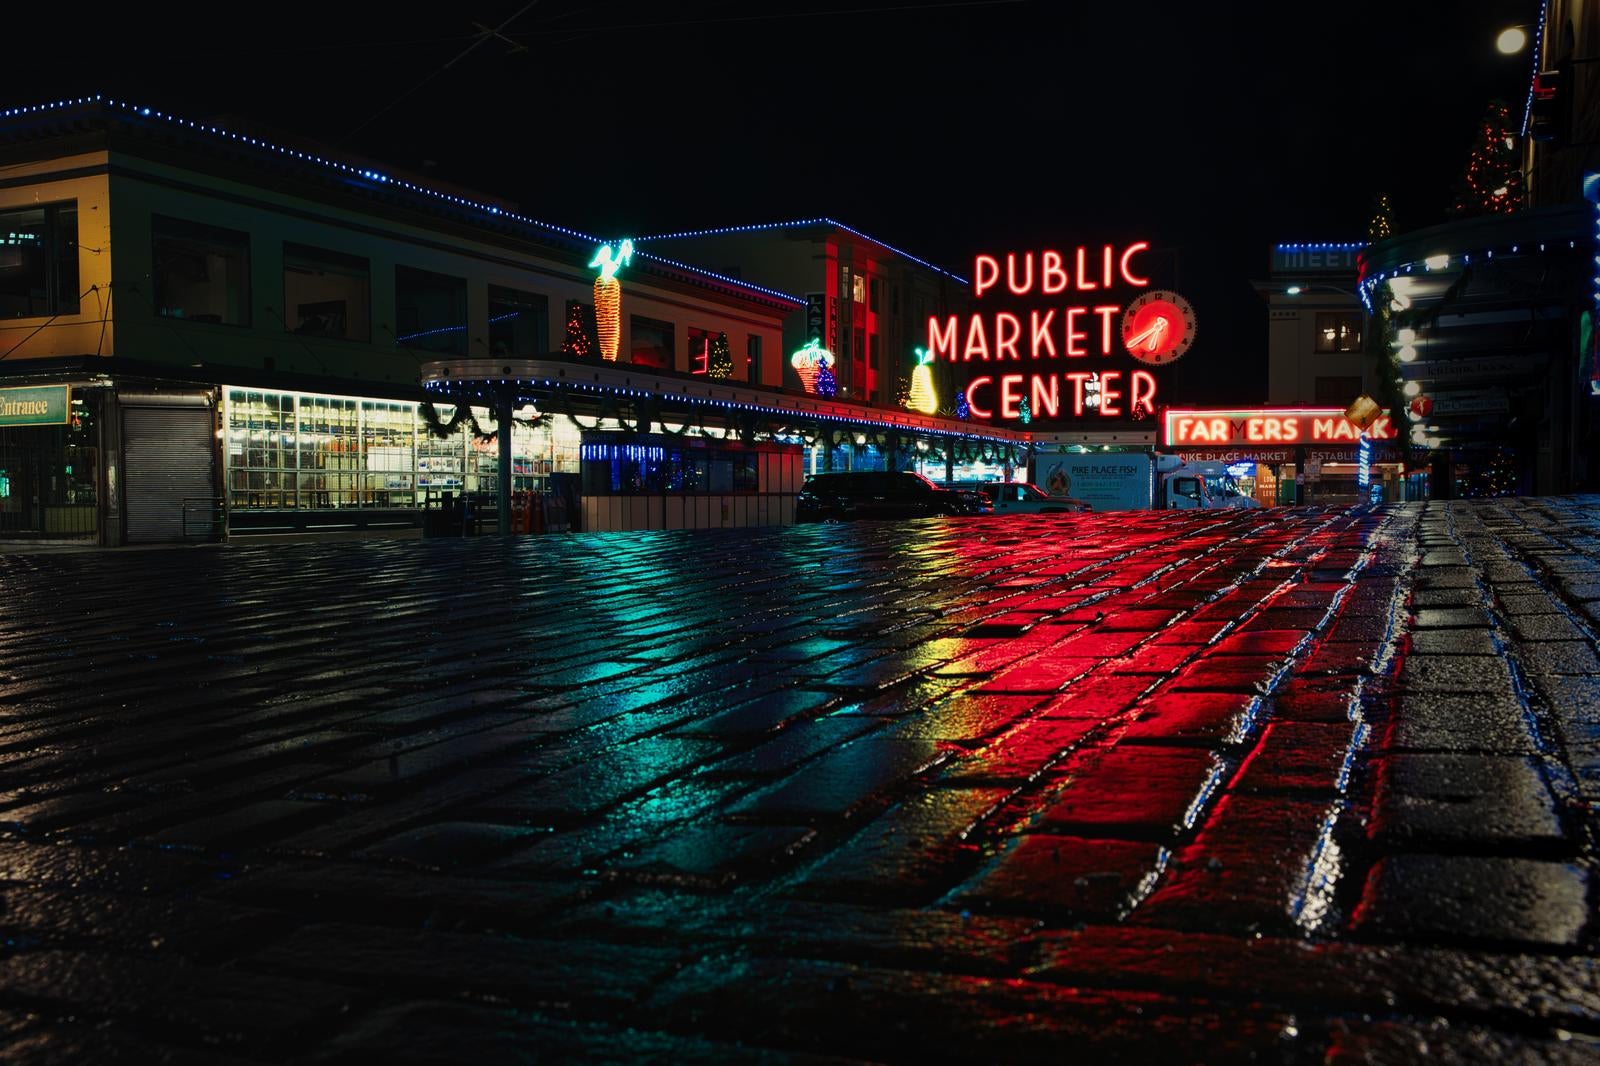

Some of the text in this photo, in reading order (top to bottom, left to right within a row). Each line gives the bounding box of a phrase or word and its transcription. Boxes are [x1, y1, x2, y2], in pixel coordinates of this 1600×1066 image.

[975, 242, 1149, 297] PUBLIC
[927, 304, 1121, 362] MARKET
[966, 370, 1157, 419] CENTER
[1178, 418, 1398, 441] FARMERS MAK
[1206, 452, 1240, 462] PLACE
[1243, 451, 1288, 462] MARKET
[1311, 451, 1383, 461] ESTABLISED
[1072, 465, 1137, 474] PIKE PLACE FISH
